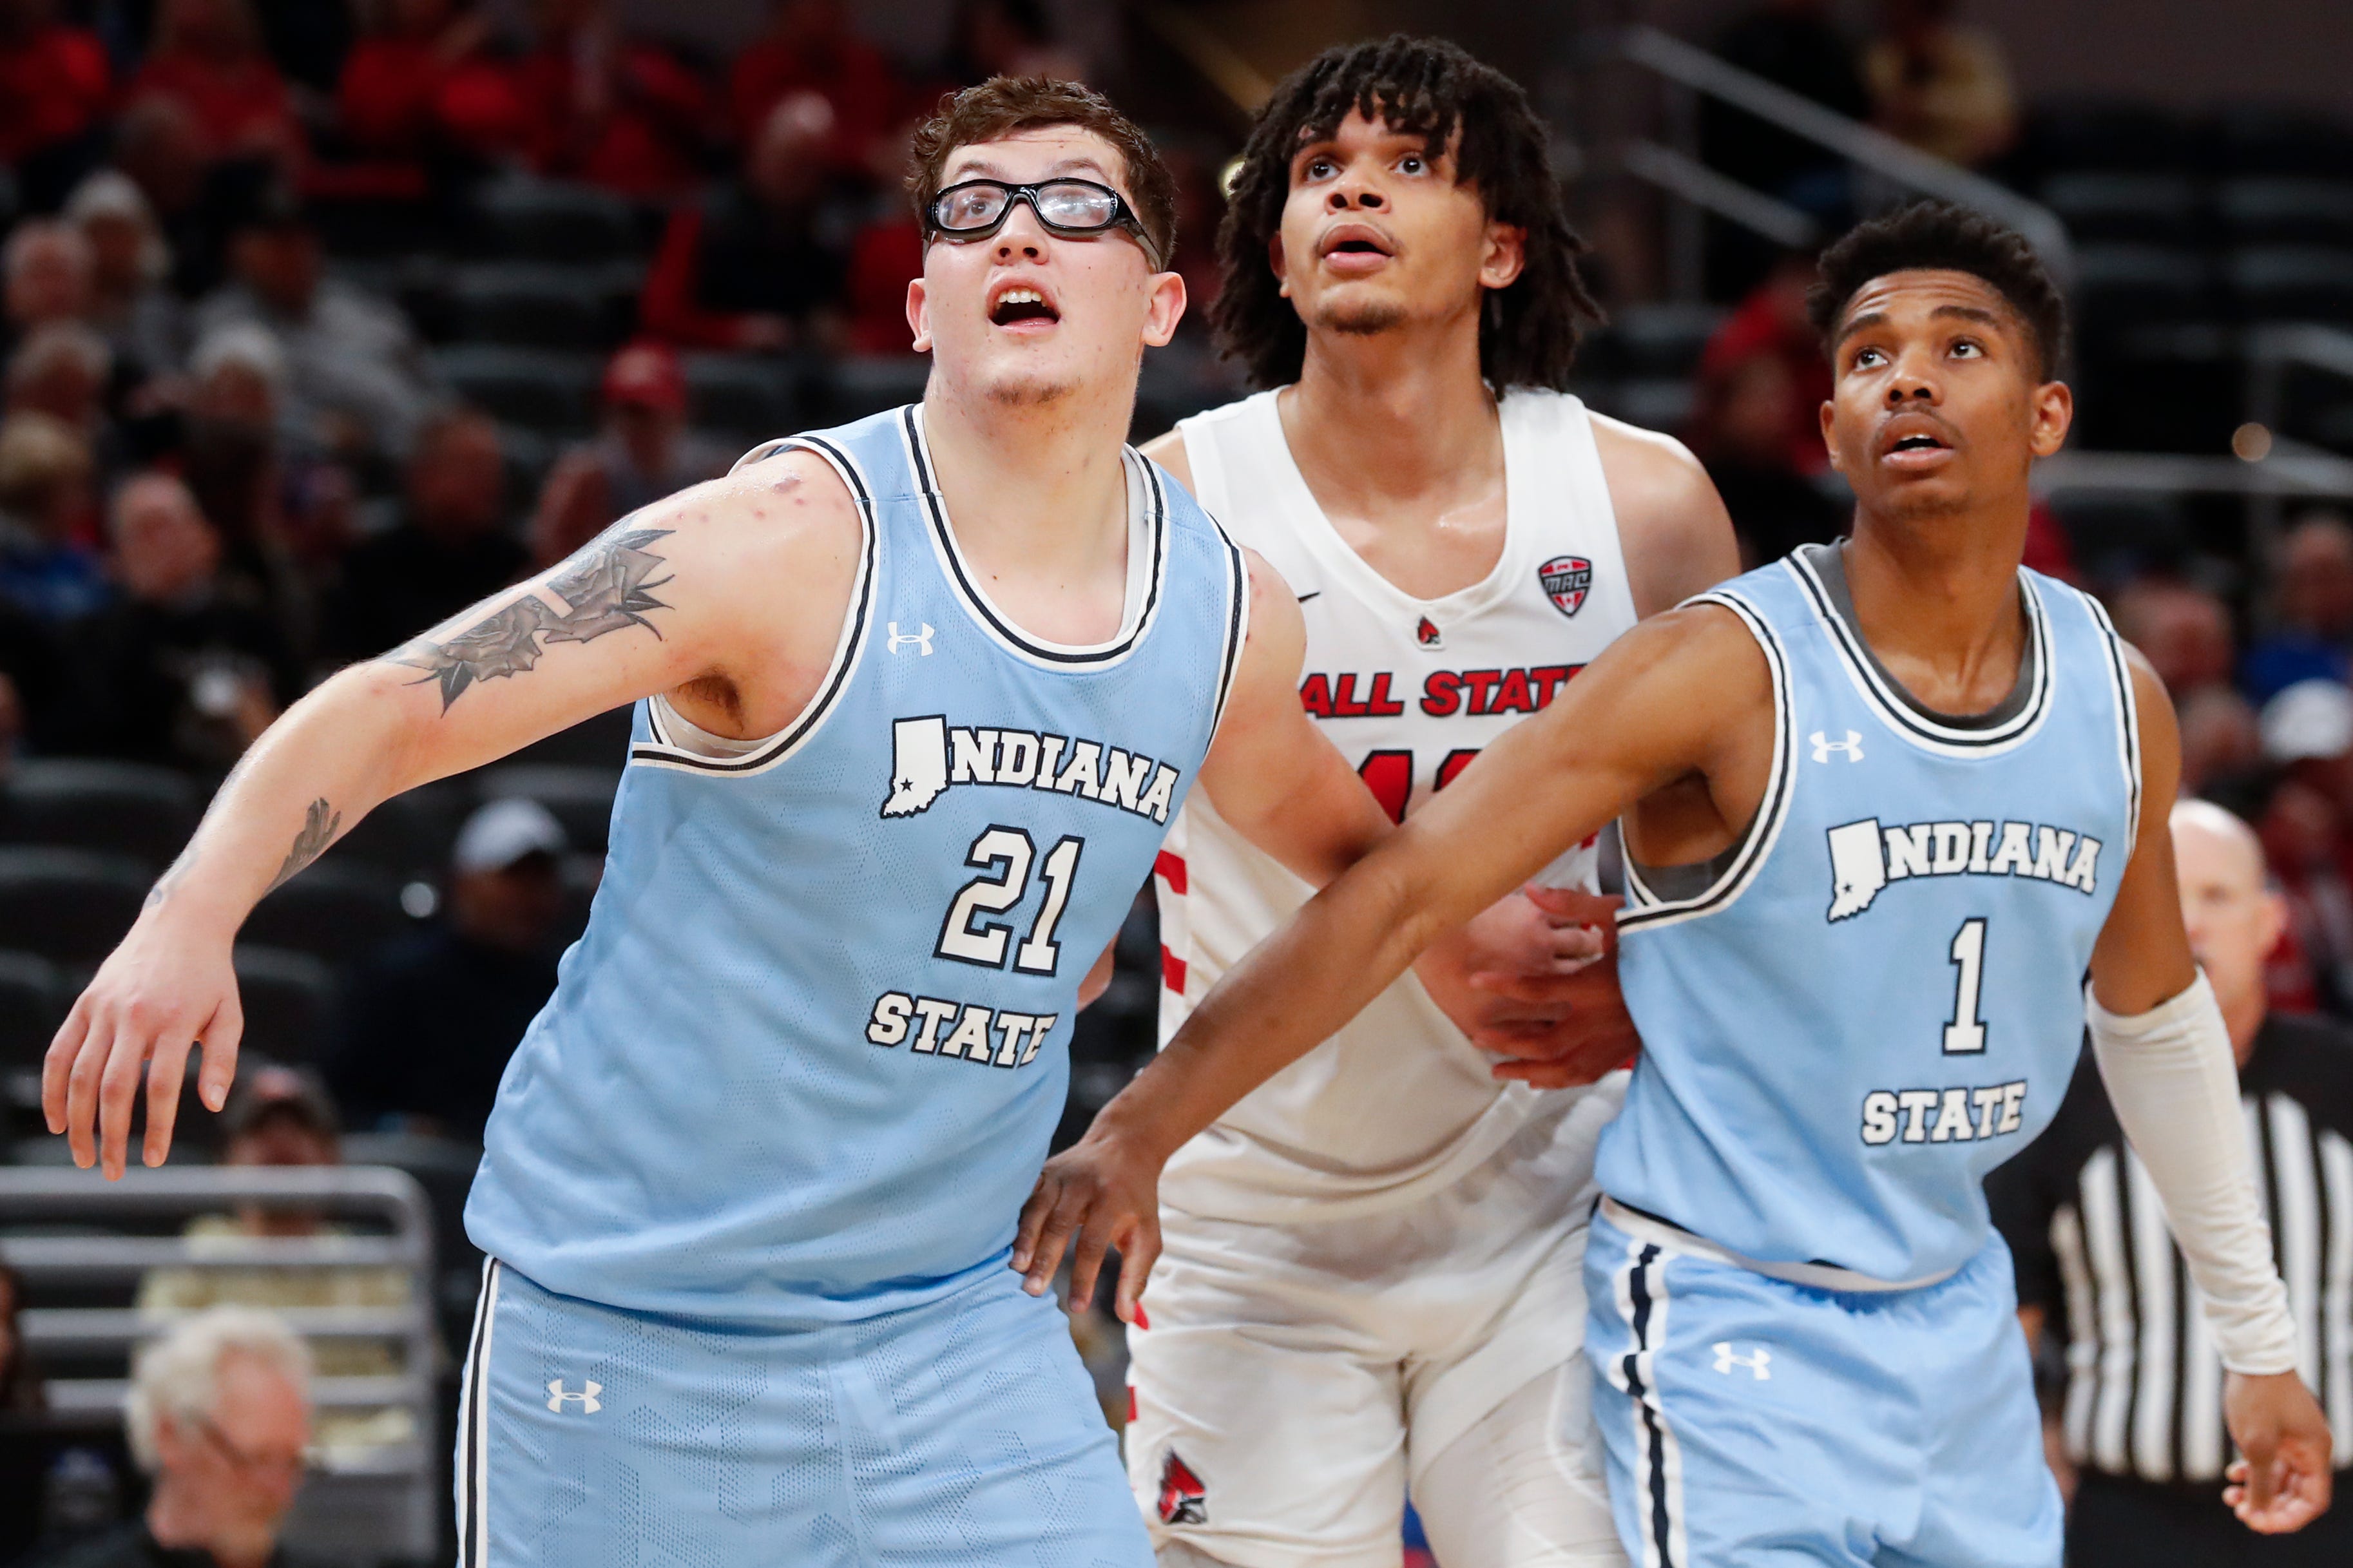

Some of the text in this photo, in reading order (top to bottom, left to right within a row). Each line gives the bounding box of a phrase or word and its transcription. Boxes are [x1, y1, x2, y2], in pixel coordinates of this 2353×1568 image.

[1300, 672, 1405, 719] ALL
[932, 823, 1086, 977] 21
[1941, 916, 1988, 1056] 1
[1861, 1078, 2028, 1147] STATE
